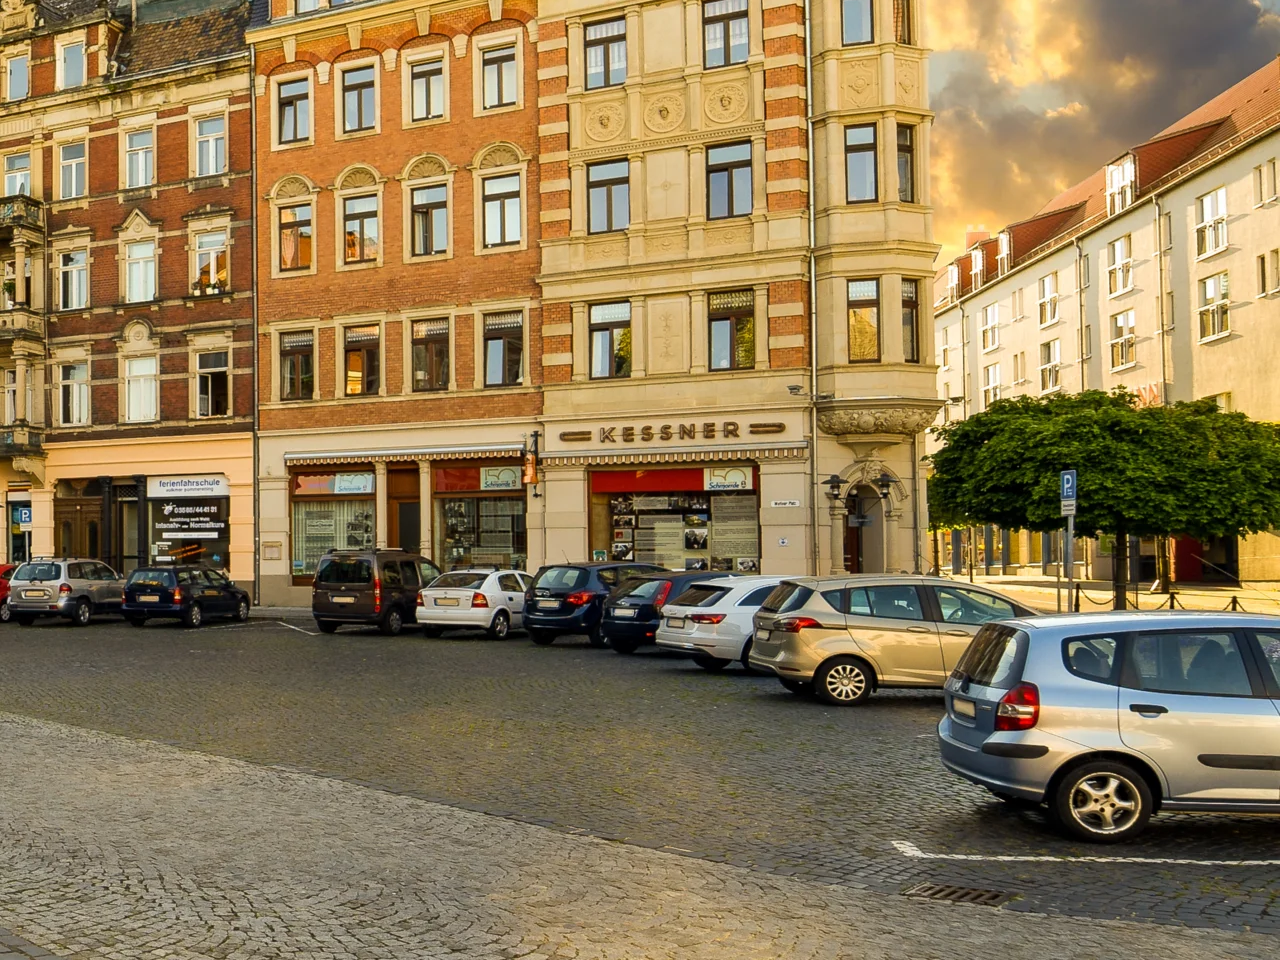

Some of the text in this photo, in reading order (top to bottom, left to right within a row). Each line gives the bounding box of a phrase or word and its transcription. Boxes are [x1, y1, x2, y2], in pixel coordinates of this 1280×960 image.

[600, 421, 740, 443] KESSNER
[485, 468, 517, 481] 150
[710, 468, 746, 481] 150
[159, 479, 220, 487] ferienfahrschule
[1063, 474, 1073, 496] P
[22, 510, 30, 521] P
